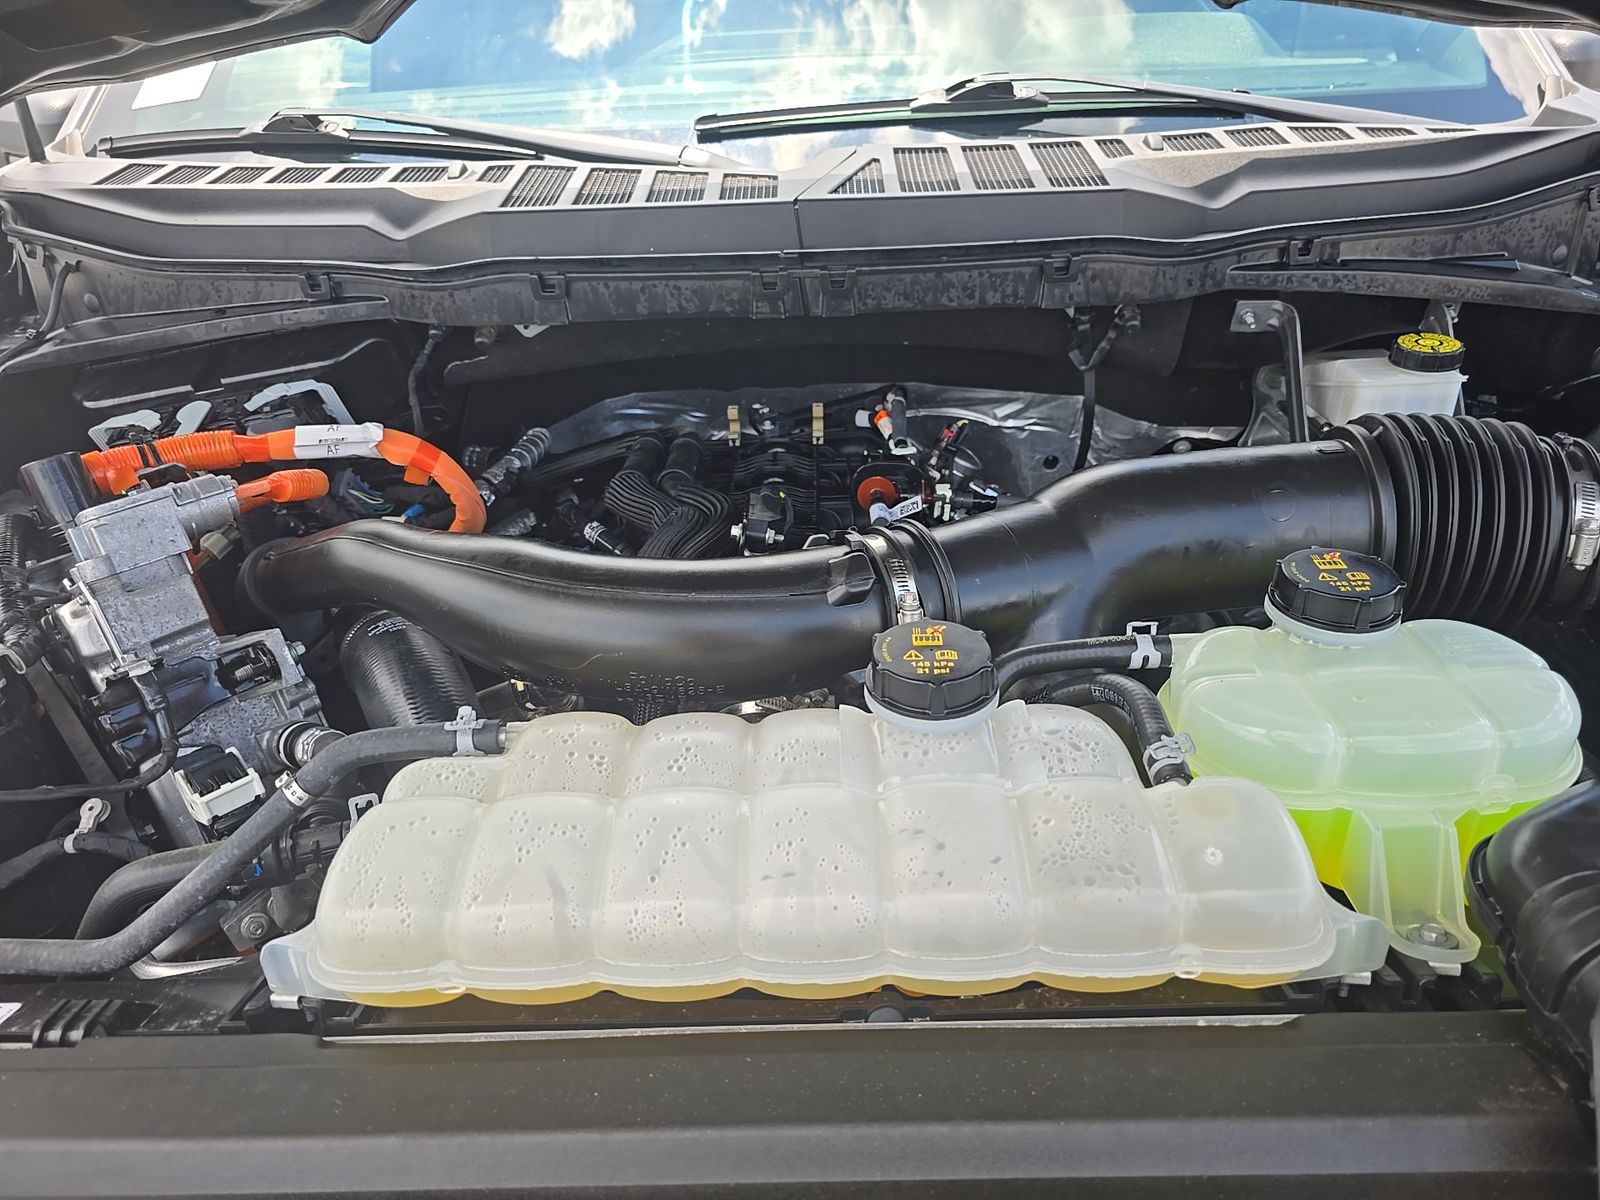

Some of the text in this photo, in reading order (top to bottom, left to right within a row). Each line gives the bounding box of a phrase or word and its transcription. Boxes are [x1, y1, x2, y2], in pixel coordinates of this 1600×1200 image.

[327, 445, 340, 455] AF
[916, 667, 950, 675] 21 psi
